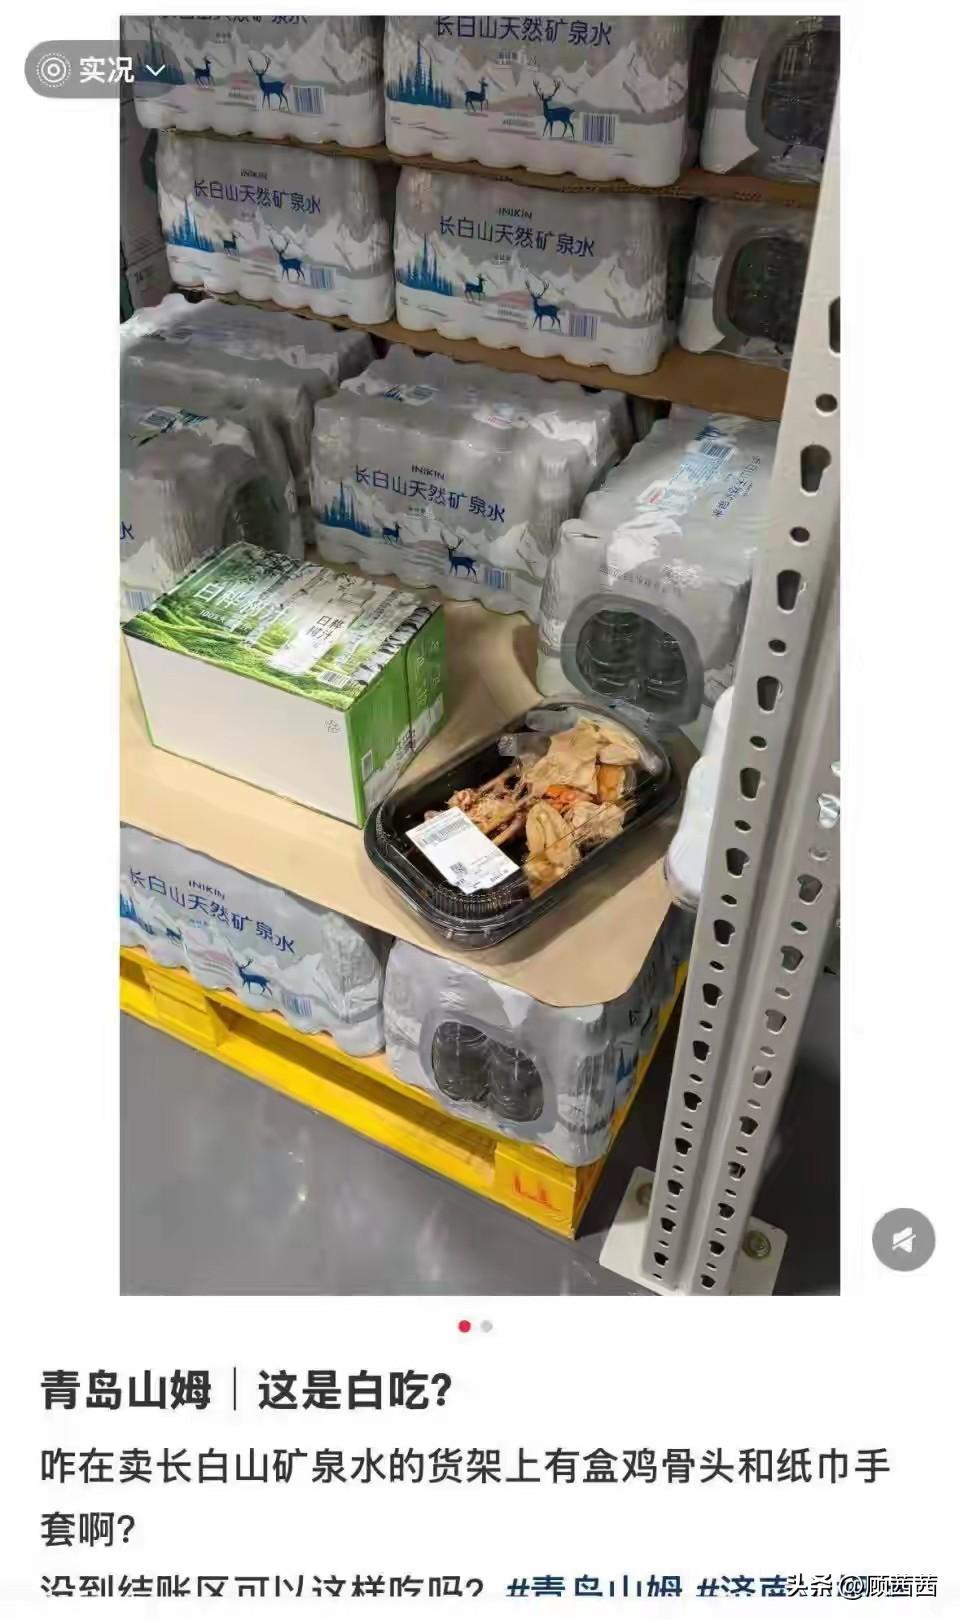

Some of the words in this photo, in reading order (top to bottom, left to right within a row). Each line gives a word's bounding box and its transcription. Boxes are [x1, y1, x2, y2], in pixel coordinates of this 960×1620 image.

[435, 16, 613, 46] 长白山天然矿泉水
[193, 179, 321, 215] 长白山天然矿泉水
[498, 207, 533, 220] INIKIN
[440, 215, 595, 258] 长白山天然矿泉水
[353, 464, 506, 523] 长白山天然矿泉水
[188, 879, 226, 901] INIKIN
[128, 867, 297, 955] 长白山天然矿泉水
